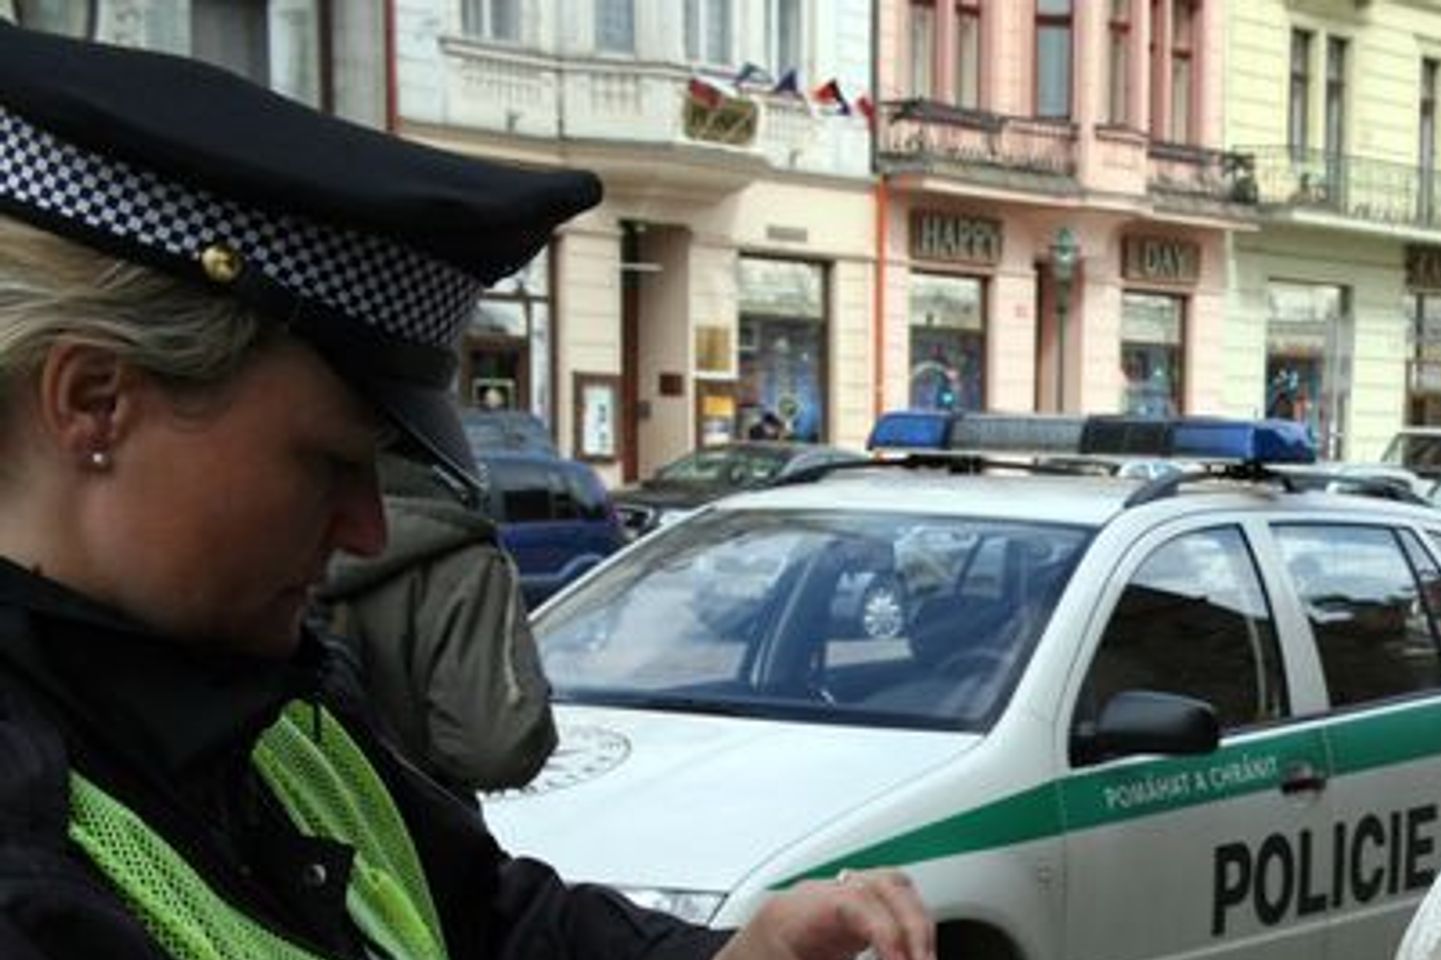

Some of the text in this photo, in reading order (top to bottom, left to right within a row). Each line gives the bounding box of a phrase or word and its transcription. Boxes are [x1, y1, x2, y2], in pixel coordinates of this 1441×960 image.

[921, 215, 1190, 280] HAPPY DAY
[1193, 769, 1209, 793] A
[1211, 803, 1439, 937] POLICIE
